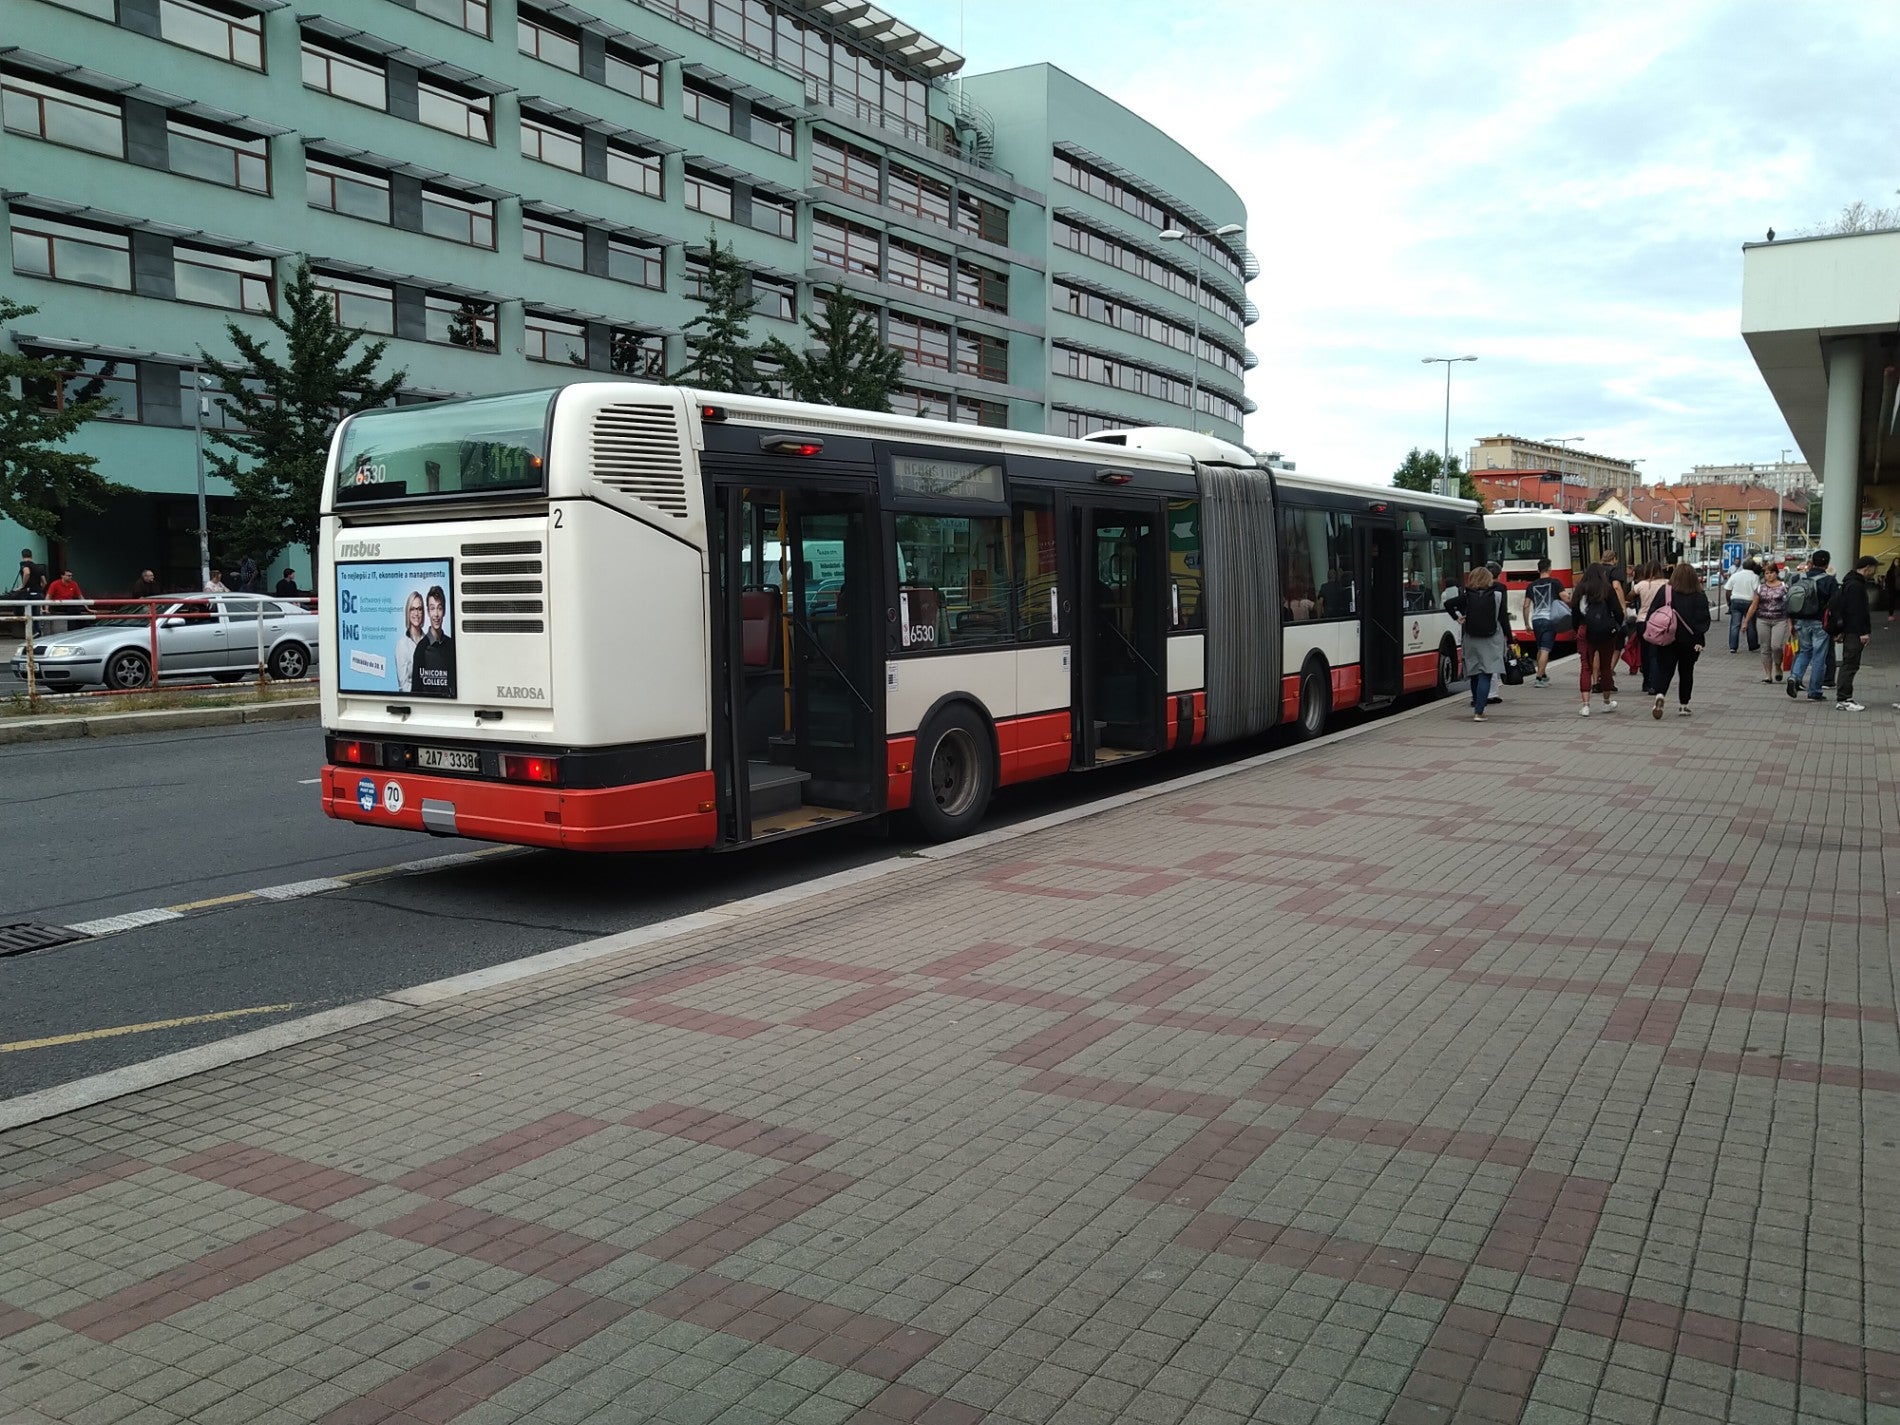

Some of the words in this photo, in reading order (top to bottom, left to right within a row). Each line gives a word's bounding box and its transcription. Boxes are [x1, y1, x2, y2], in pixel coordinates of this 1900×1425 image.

[490, 443, 528, 480] 144
[355, 464, 386, 485] 6530
[553, 508, 563, 529] 2
[1514, 539, 1532, 552] 200
[379, 570, 403, 579] ekonomie
[409, 570, 446, 579] managementu
[910, 625, 935, 642] 6530
[496, 685, 545, 700] KAROSA
[425, 750, 443, 766] 2A7
[449, 752, 474, 769] 3338
[387, 786, 400, 802] 70
